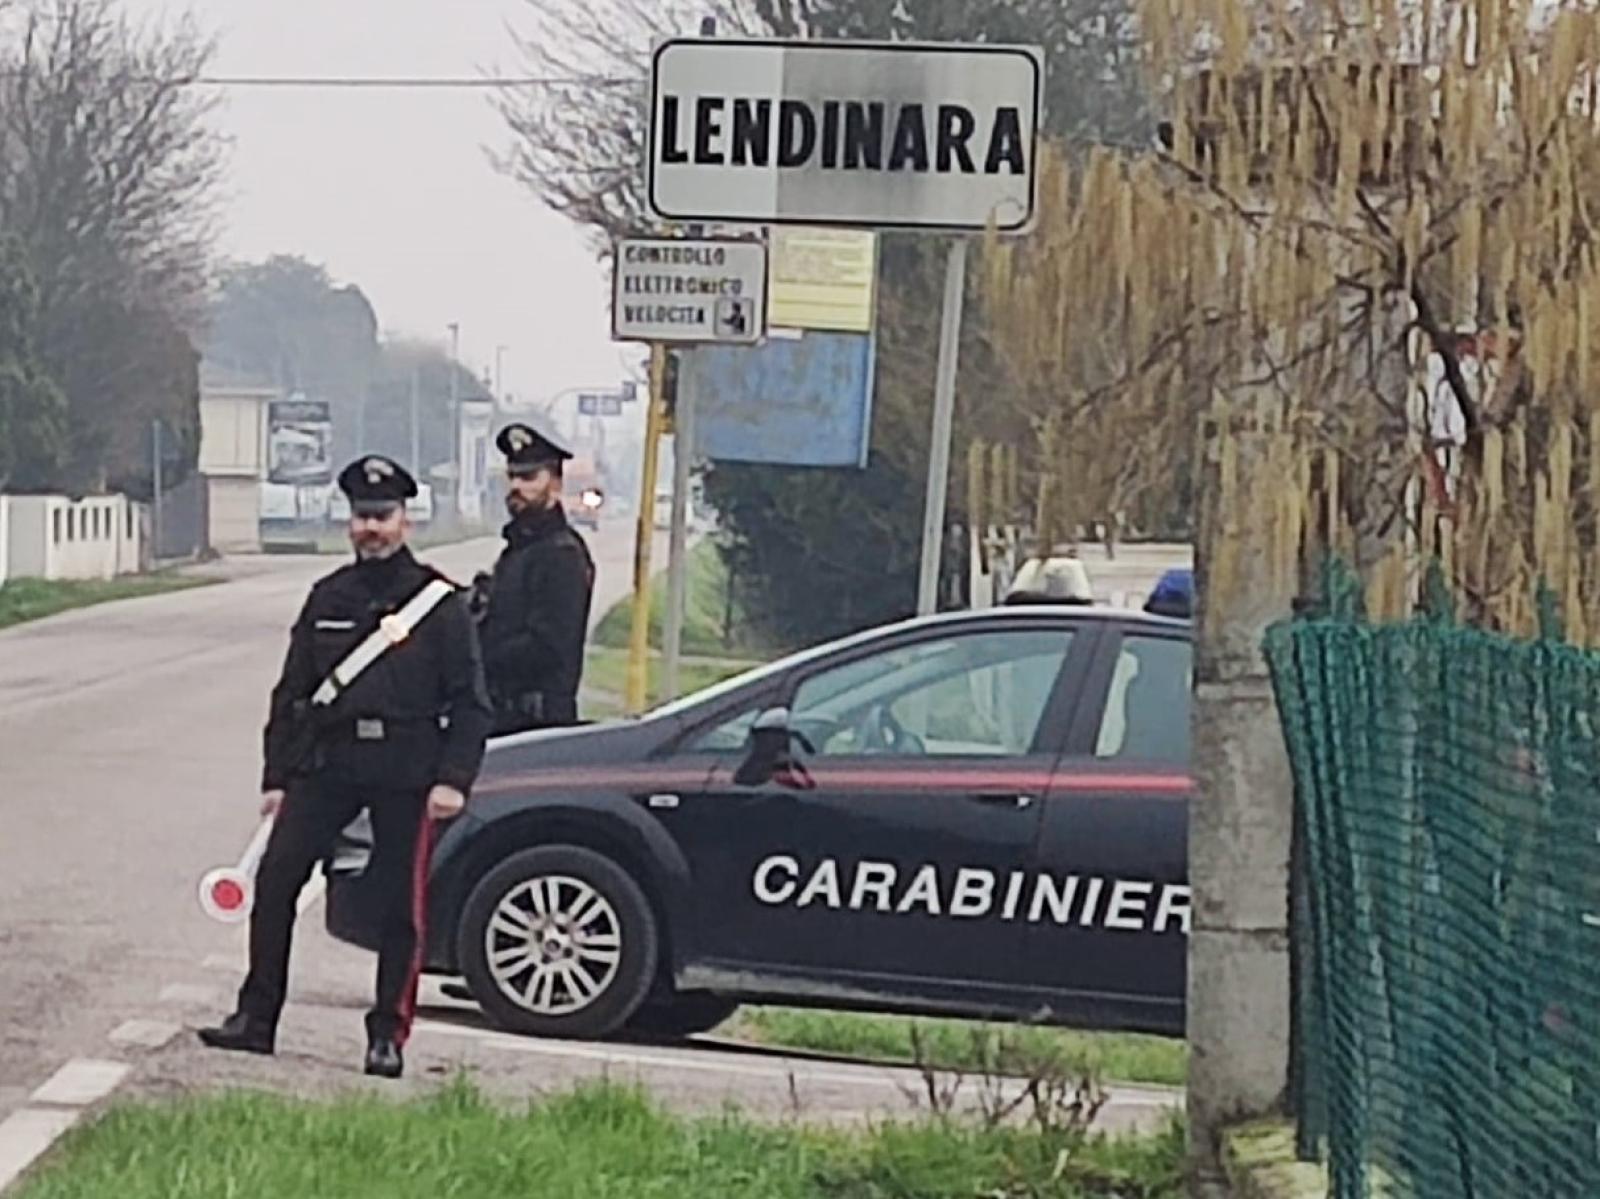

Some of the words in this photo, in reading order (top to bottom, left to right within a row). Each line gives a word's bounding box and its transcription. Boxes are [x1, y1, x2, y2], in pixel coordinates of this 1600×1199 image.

[661, 95, 1025, 174] LENDINARA
[625, 246, 726, 267] CONTROLLO
[624, 275, 744, 296] ELETTRONICO
